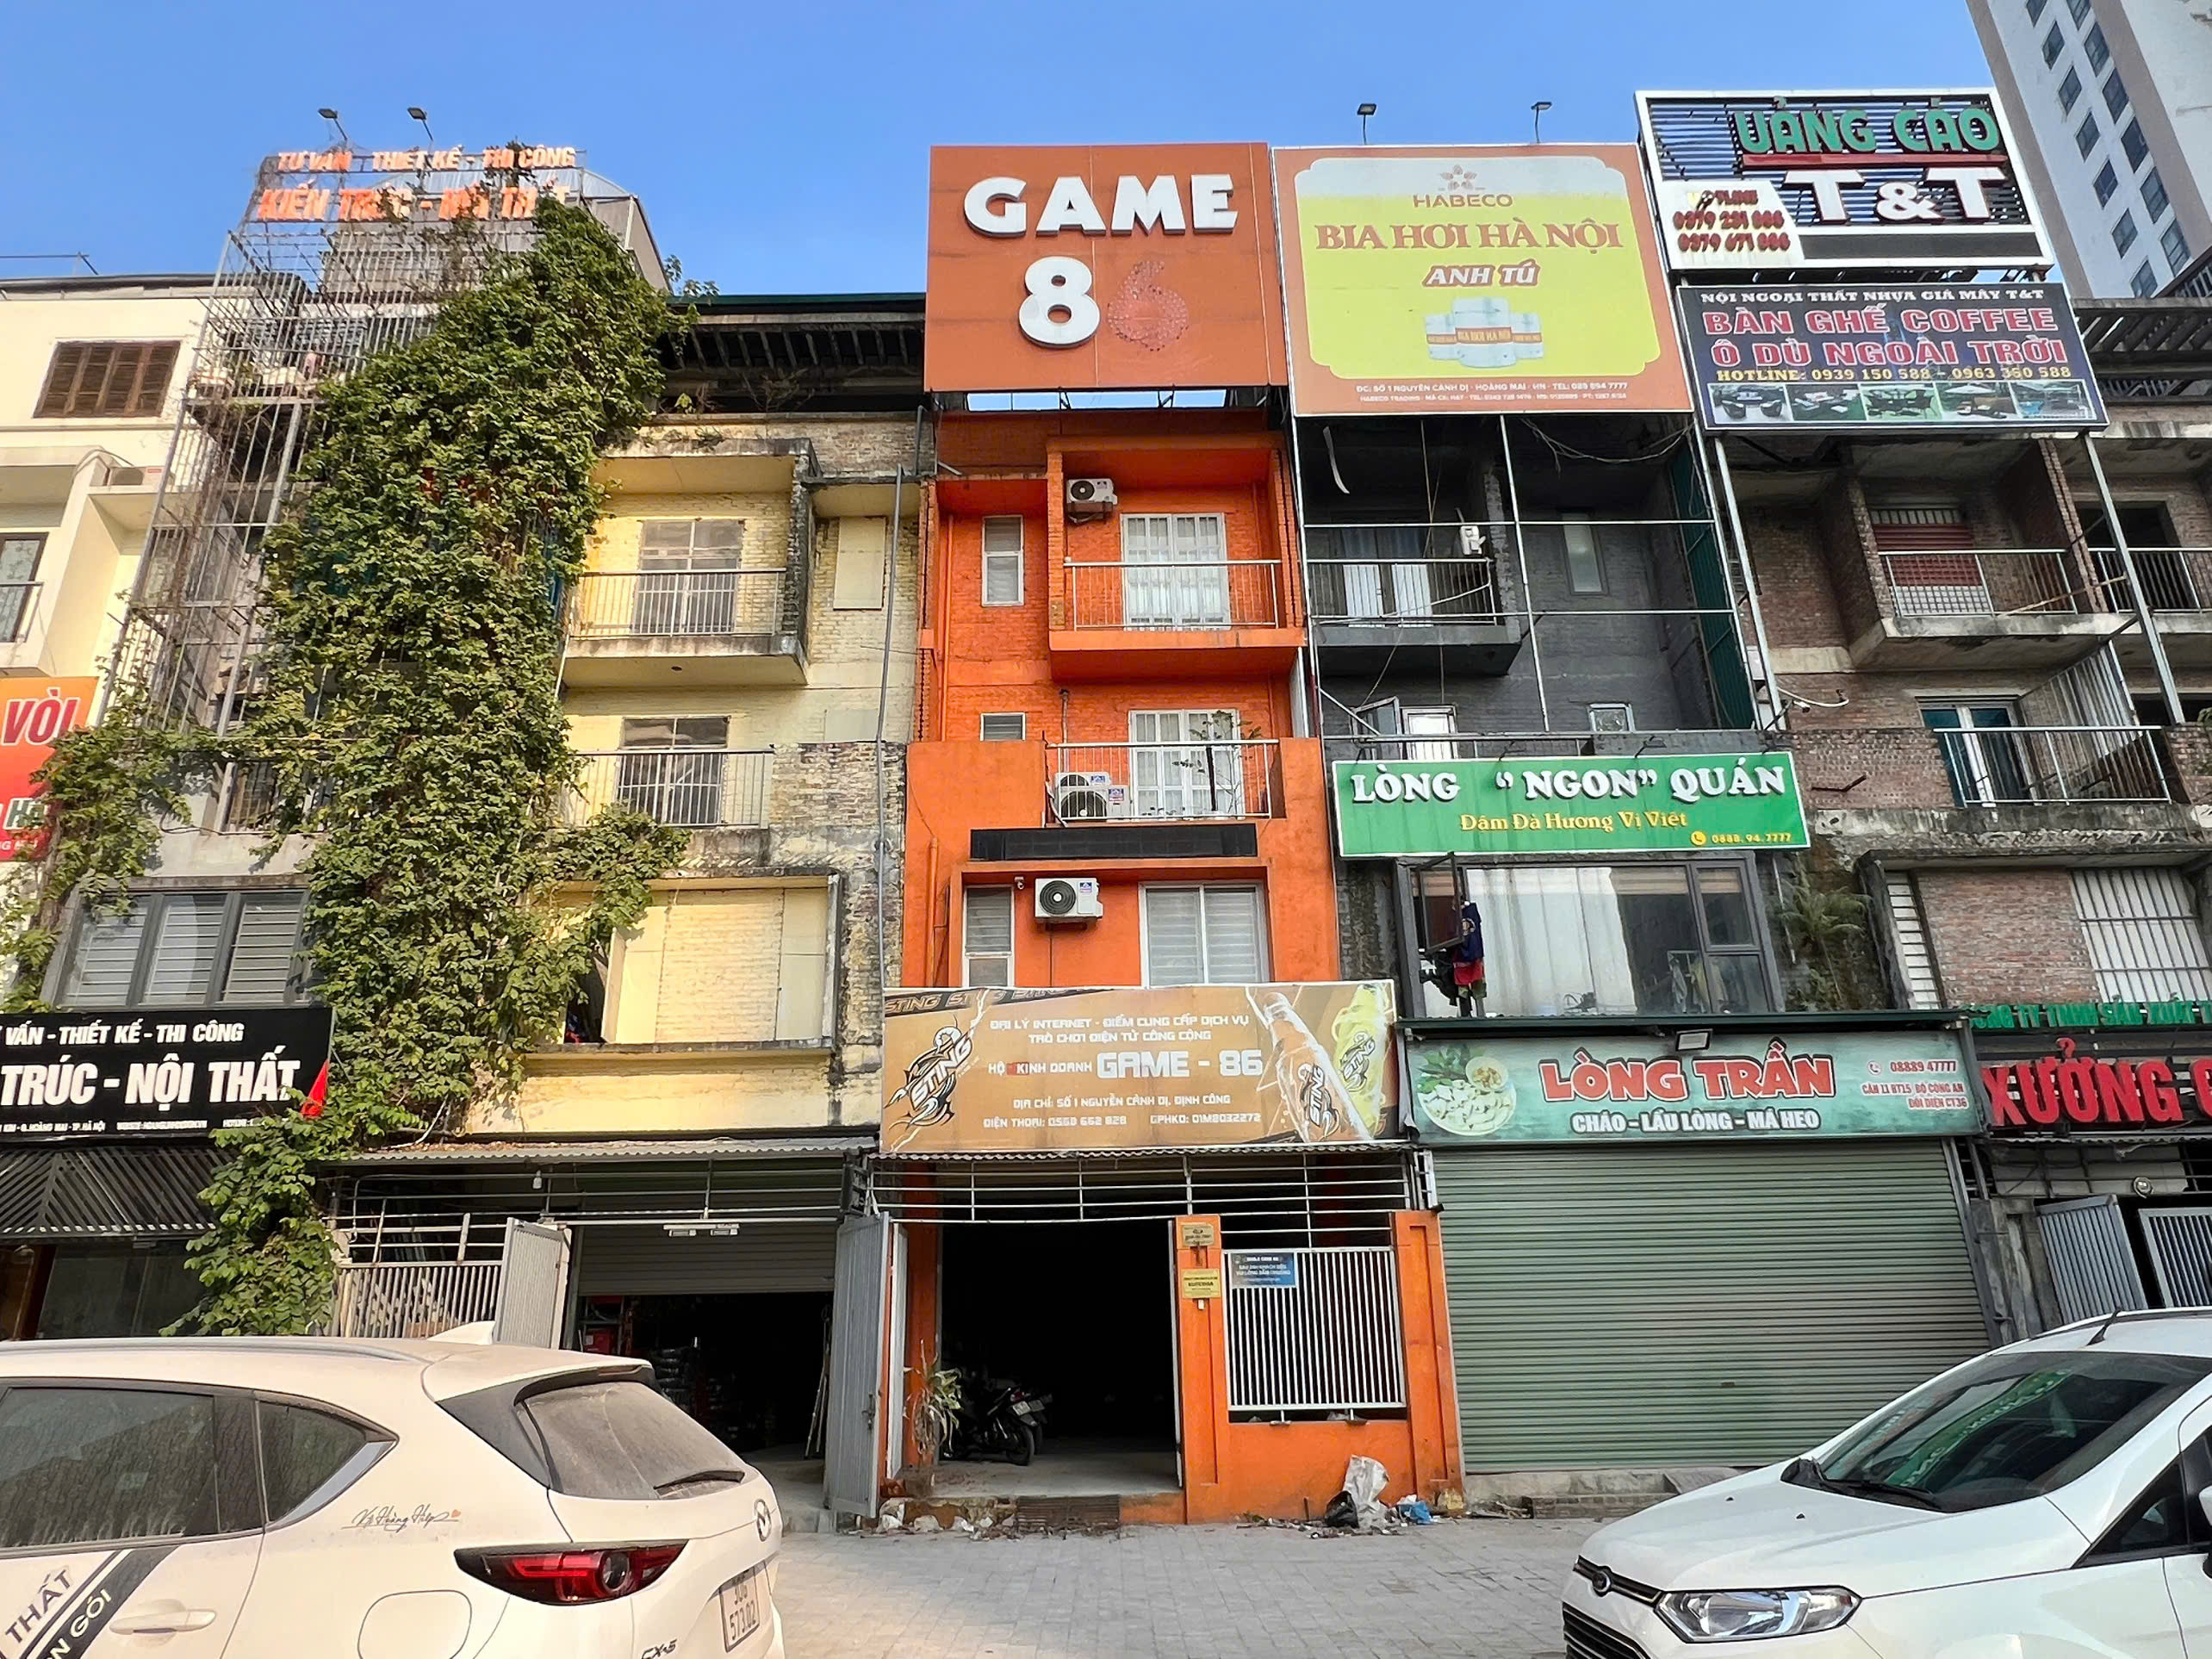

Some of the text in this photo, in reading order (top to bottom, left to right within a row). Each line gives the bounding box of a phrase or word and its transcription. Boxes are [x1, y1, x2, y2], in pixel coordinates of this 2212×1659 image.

[519, 144, 576, 168] CÔNG
[963, 174, 1239, 237] GAME
[1413, 194, 1513, 208] HABECO
[1784, 167, 2009, 223] T & T
[1314, 217, 1624, 254] BIA HƠI HÀ NỘI
[1426, 260, 1538, 286] ANH TÚ
[1700, 291, 1737, 304] NỘI
[1808, 289, 1858, 302] THẤT
[2005, 289, 2045, 300] T&T
[1702, 302, 2059, 335] BÀN GHẾ COFFEE
[1711, 334, 2068, 368] Ô DÙ NGOÀI TRỜI
[1716, 370, 1807, 382] HOTLINE:
[1811, 369, 1855, 380] 0939
[1861, 369, 1892, 380] 150
[1952, 367, 1996, 379] 0963
[2039, 367, 2072, 378] 588
[1351, 763, 1461, 802] LÒNG
[1669, 757, 1786, 803] QUÁN
[1544, 812, 1614, 833] Hương
[6, 1018, 245, 1045] VẤN THIẾT KẾ THI CÔNG
[1033, 1018, 1093, 1029] INTERNET
[1137, 1016, 1170, 1027] CUNG
[1142, 1029, 1176, 1041] CÔNG
[0, 1054, 98, 1106] TRÚC
[125, 1053, 195, 1111] NỘI
[208, 1045, 301, 1103] THẤT
[989, 1060, 1006, 1076] HỘ
[1050, 1062, 1092, 1074] DOANH
[1097, 1050, 1190, 1079] GAME
[1218, 1049, 1263, 1077] 86
[1539, 1039, 1836, 1102] LÒNG TRẦN
[1981, 1037, 2184, 1126] XƯỞNG
[1202, 1093, 1231, 1105] CÔNG
[1572, 1109, 1627, 1133] CHÁO
[1681, 1109, 1731, 1131] LÒNG
[1779, 1109, 1819, 1129] HEO
[5, 1569, 72, 1643] THẤT
[70, 1588, 112, 1638] GÓI
